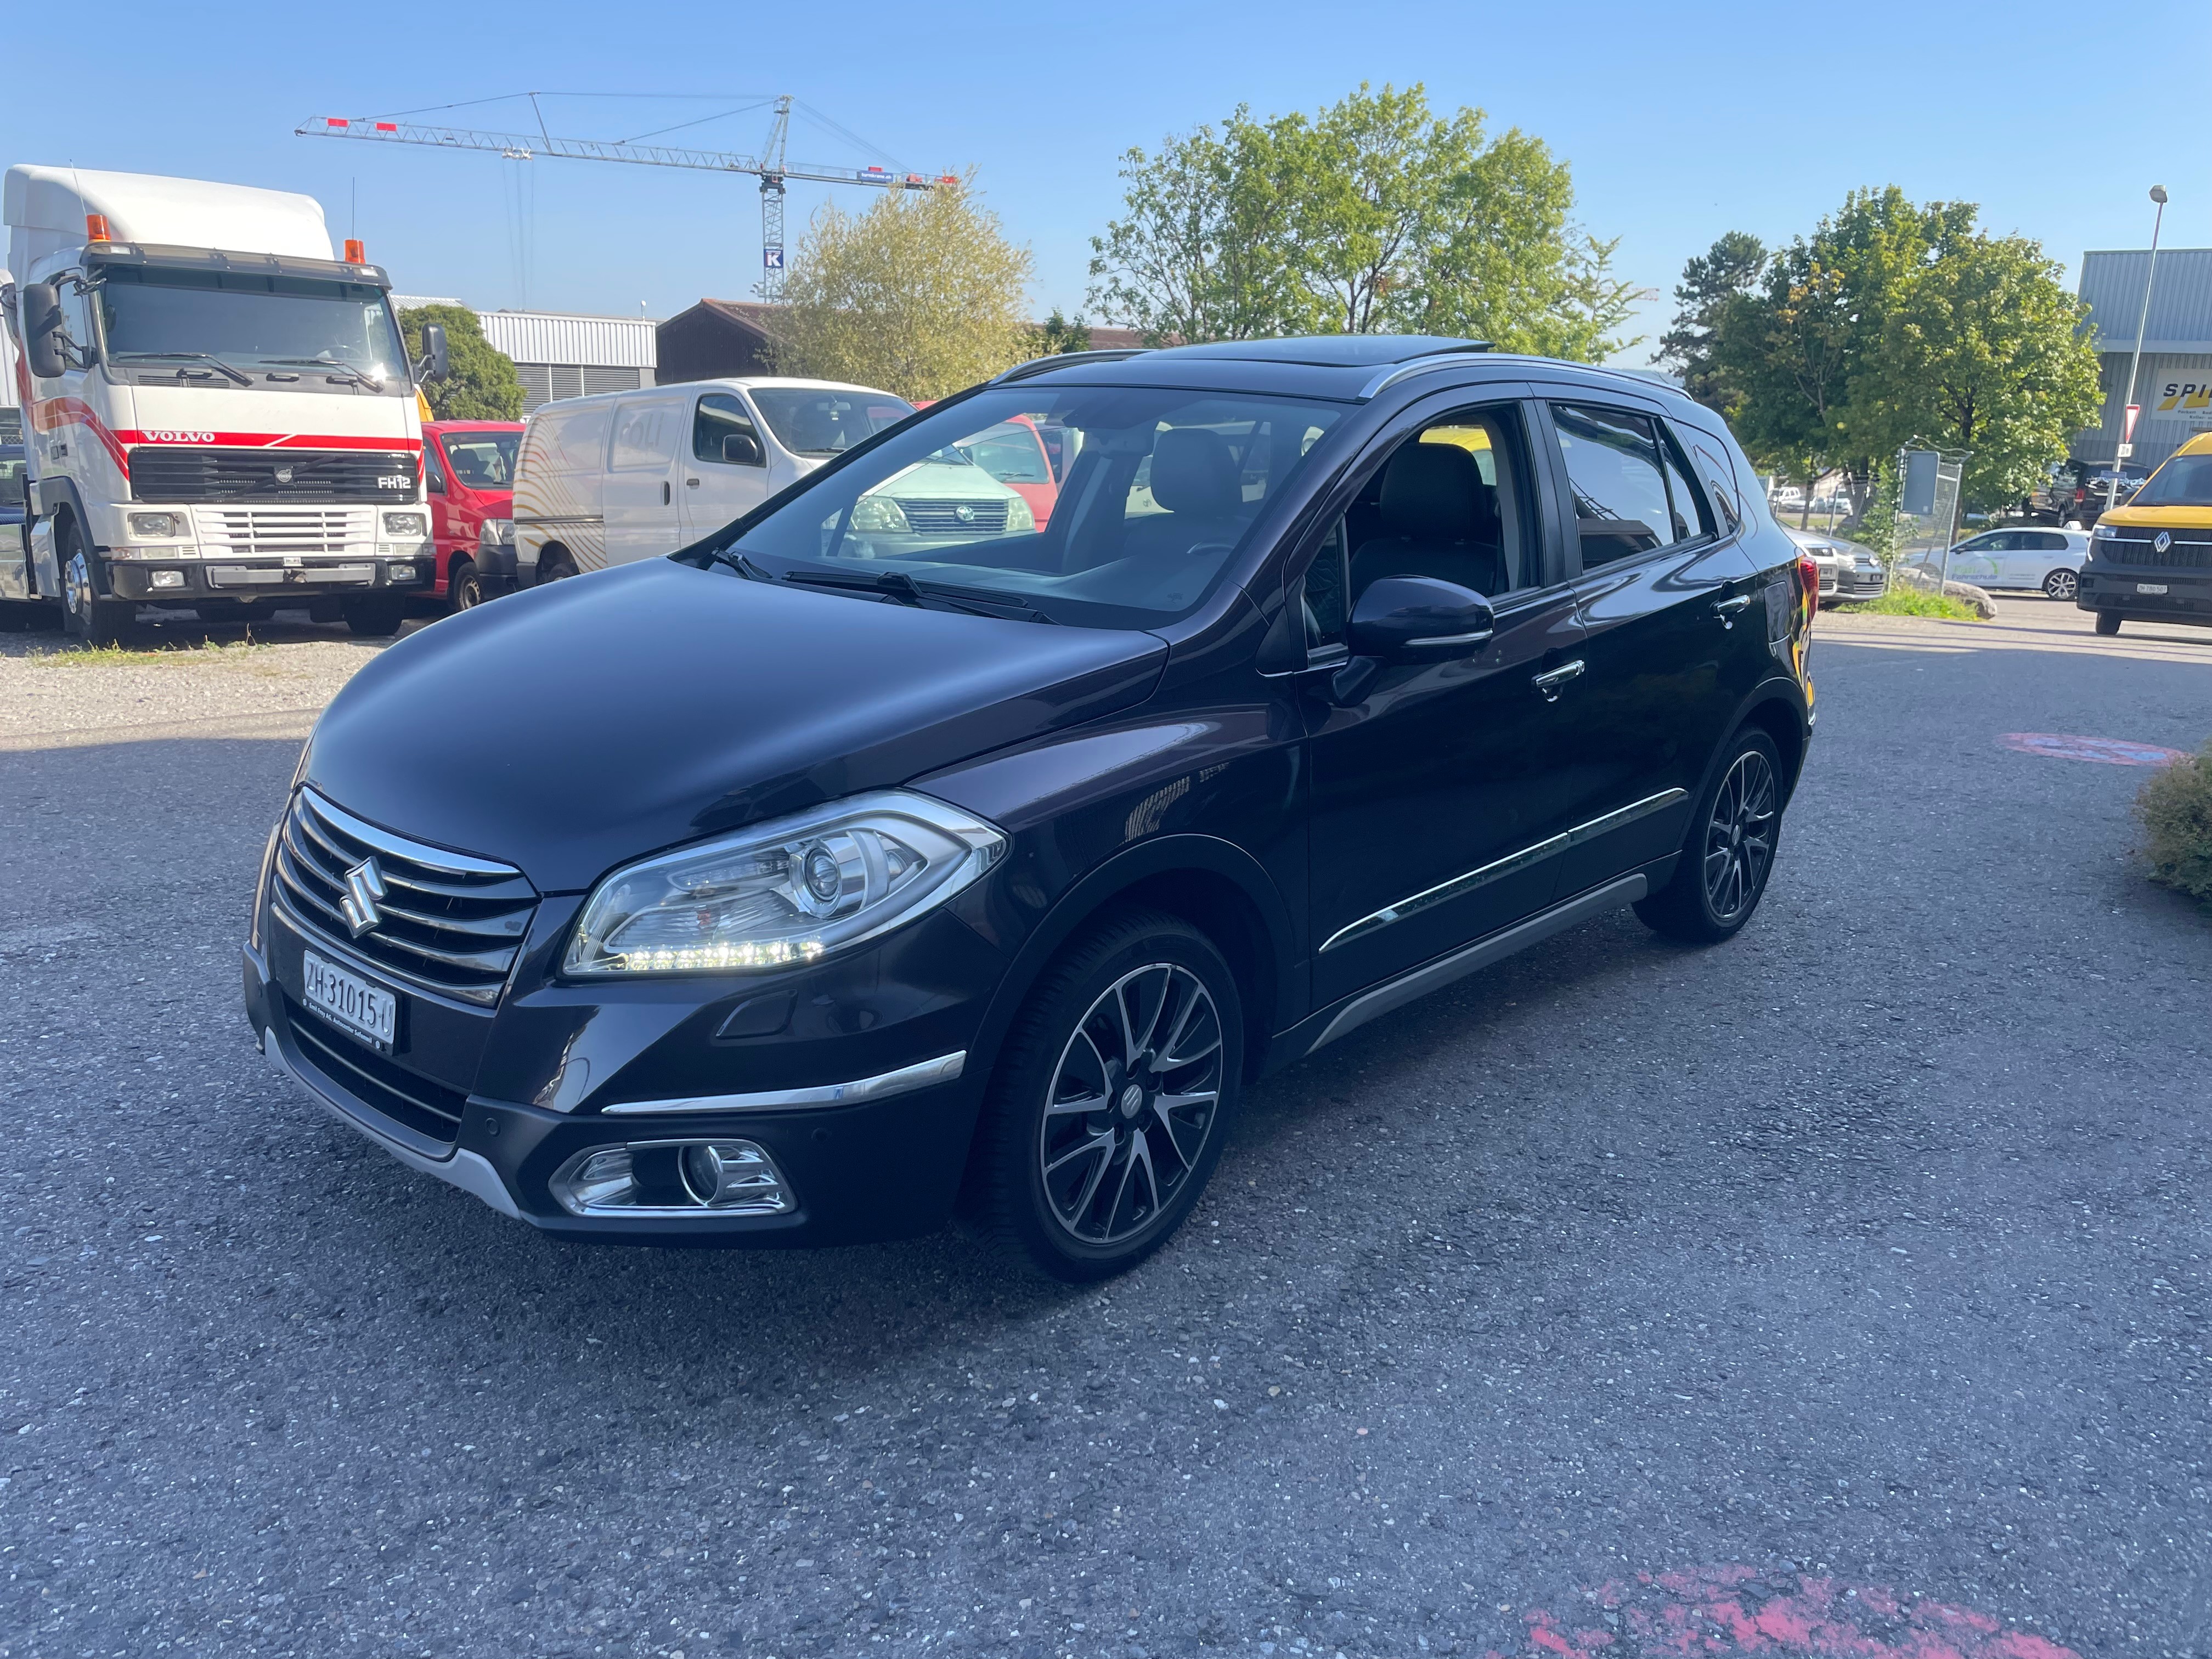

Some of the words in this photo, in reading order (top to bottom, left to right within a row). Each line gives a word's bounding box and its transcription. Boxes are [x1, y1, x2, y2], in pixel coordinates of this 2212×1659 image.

[766, 250, 781, 267] K
[2163, 383, 2212, 398] SPI
[142, 431, 216, 443] VOLVO
[377, 476, 411, 489] FH12
